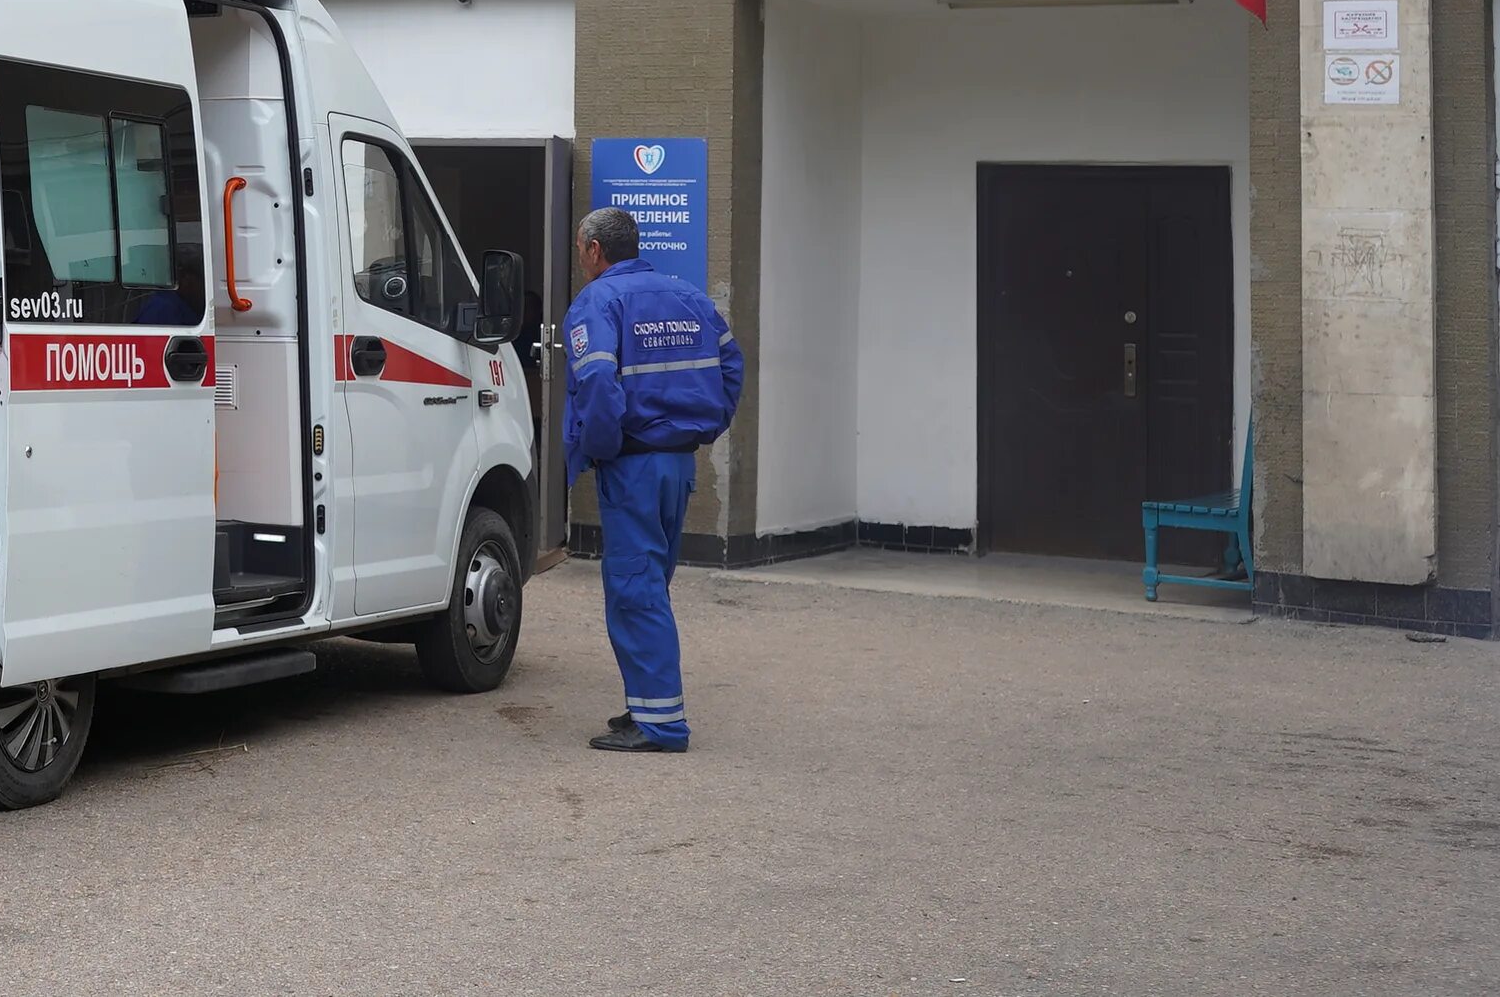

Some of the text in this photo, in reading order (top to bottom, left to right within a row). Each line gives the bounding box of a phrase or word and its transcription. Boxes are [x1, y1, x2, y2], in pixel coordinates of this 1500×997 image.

[611, 193, 688, 206] ПРИЕМНОЕ
[629, 210, 690, 224] ДЕЛЕНИЕ
[638, 241, 687, 251] ОСУТОЧНО
[10, 291, 83, 319] sev03.ru
[634, 320, 701, 335] СКОРАЯ ПОМОЩЬ
[46, 343, 145, 387] ПОМОЩЬ
[489, 360, 505, 387] 191
